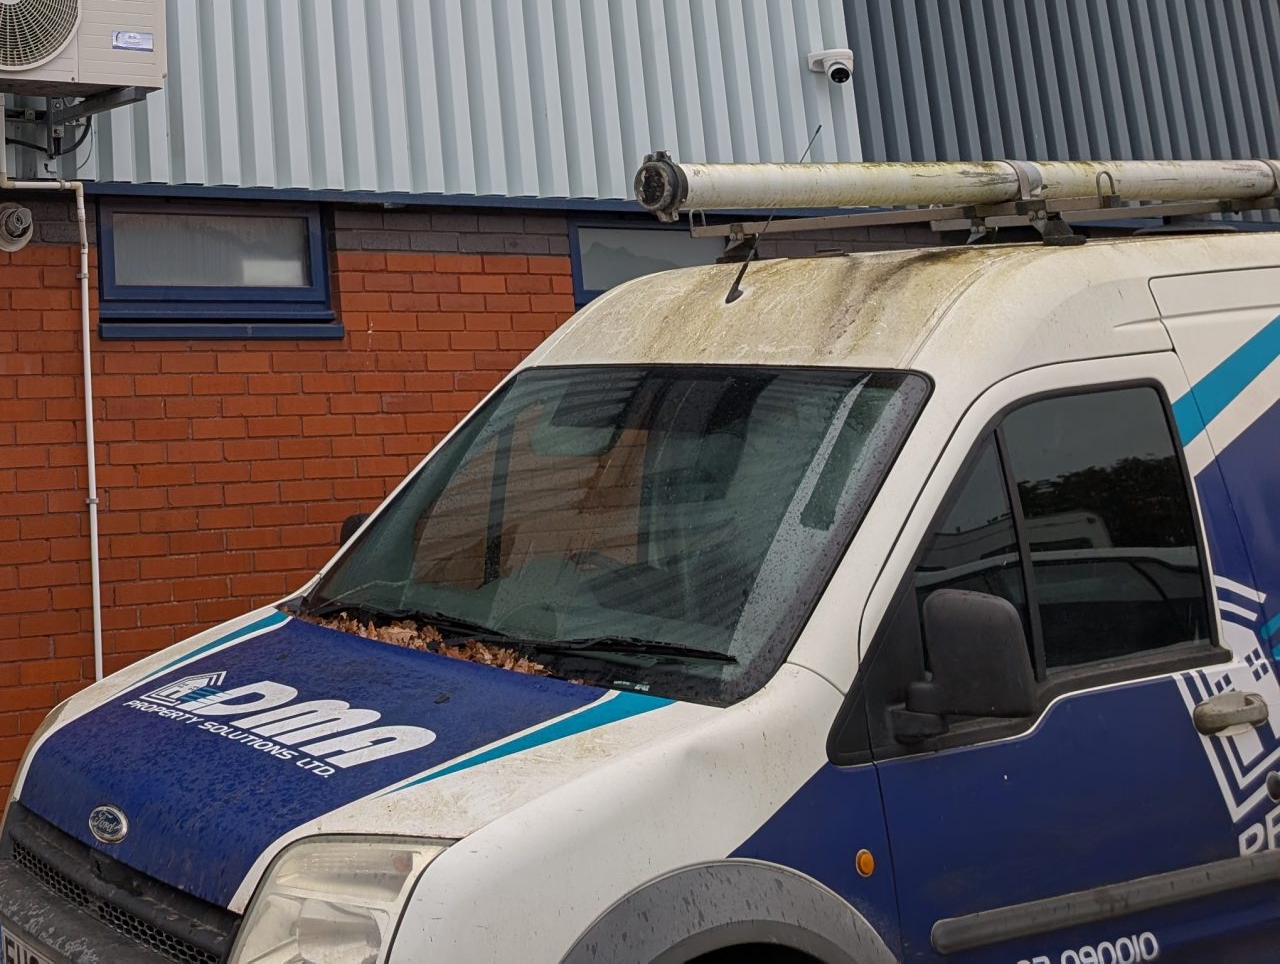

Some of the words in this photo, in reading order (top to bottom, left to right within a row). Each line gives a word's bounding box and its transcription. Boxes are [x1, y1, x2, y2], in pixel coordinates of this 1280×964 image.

[123, 700, 205, 725] PROPERTY
[197, 720, 299, 760] SOLUTIONS
[295, 758, 336, 778] LTD.
